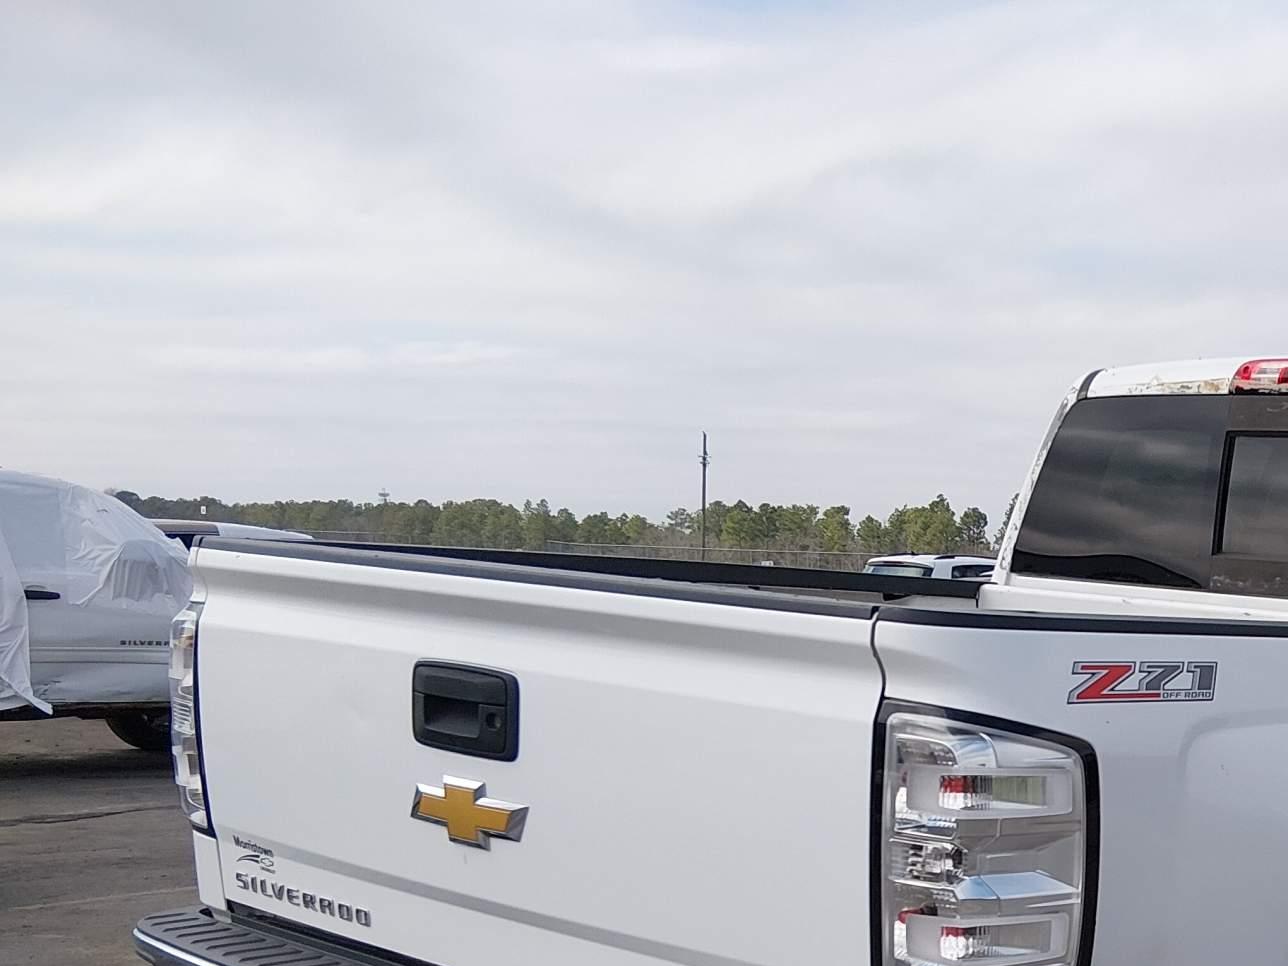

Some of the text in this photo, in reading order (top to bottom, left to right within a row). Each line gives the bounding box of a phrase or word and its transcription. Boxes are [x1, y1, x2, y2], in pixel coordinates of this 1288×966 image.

[1067, 661, 1218, 704] Z71
[1184, 691, 1212, 699] ROAD
[235, 872, 372, 928] SILVERADO
